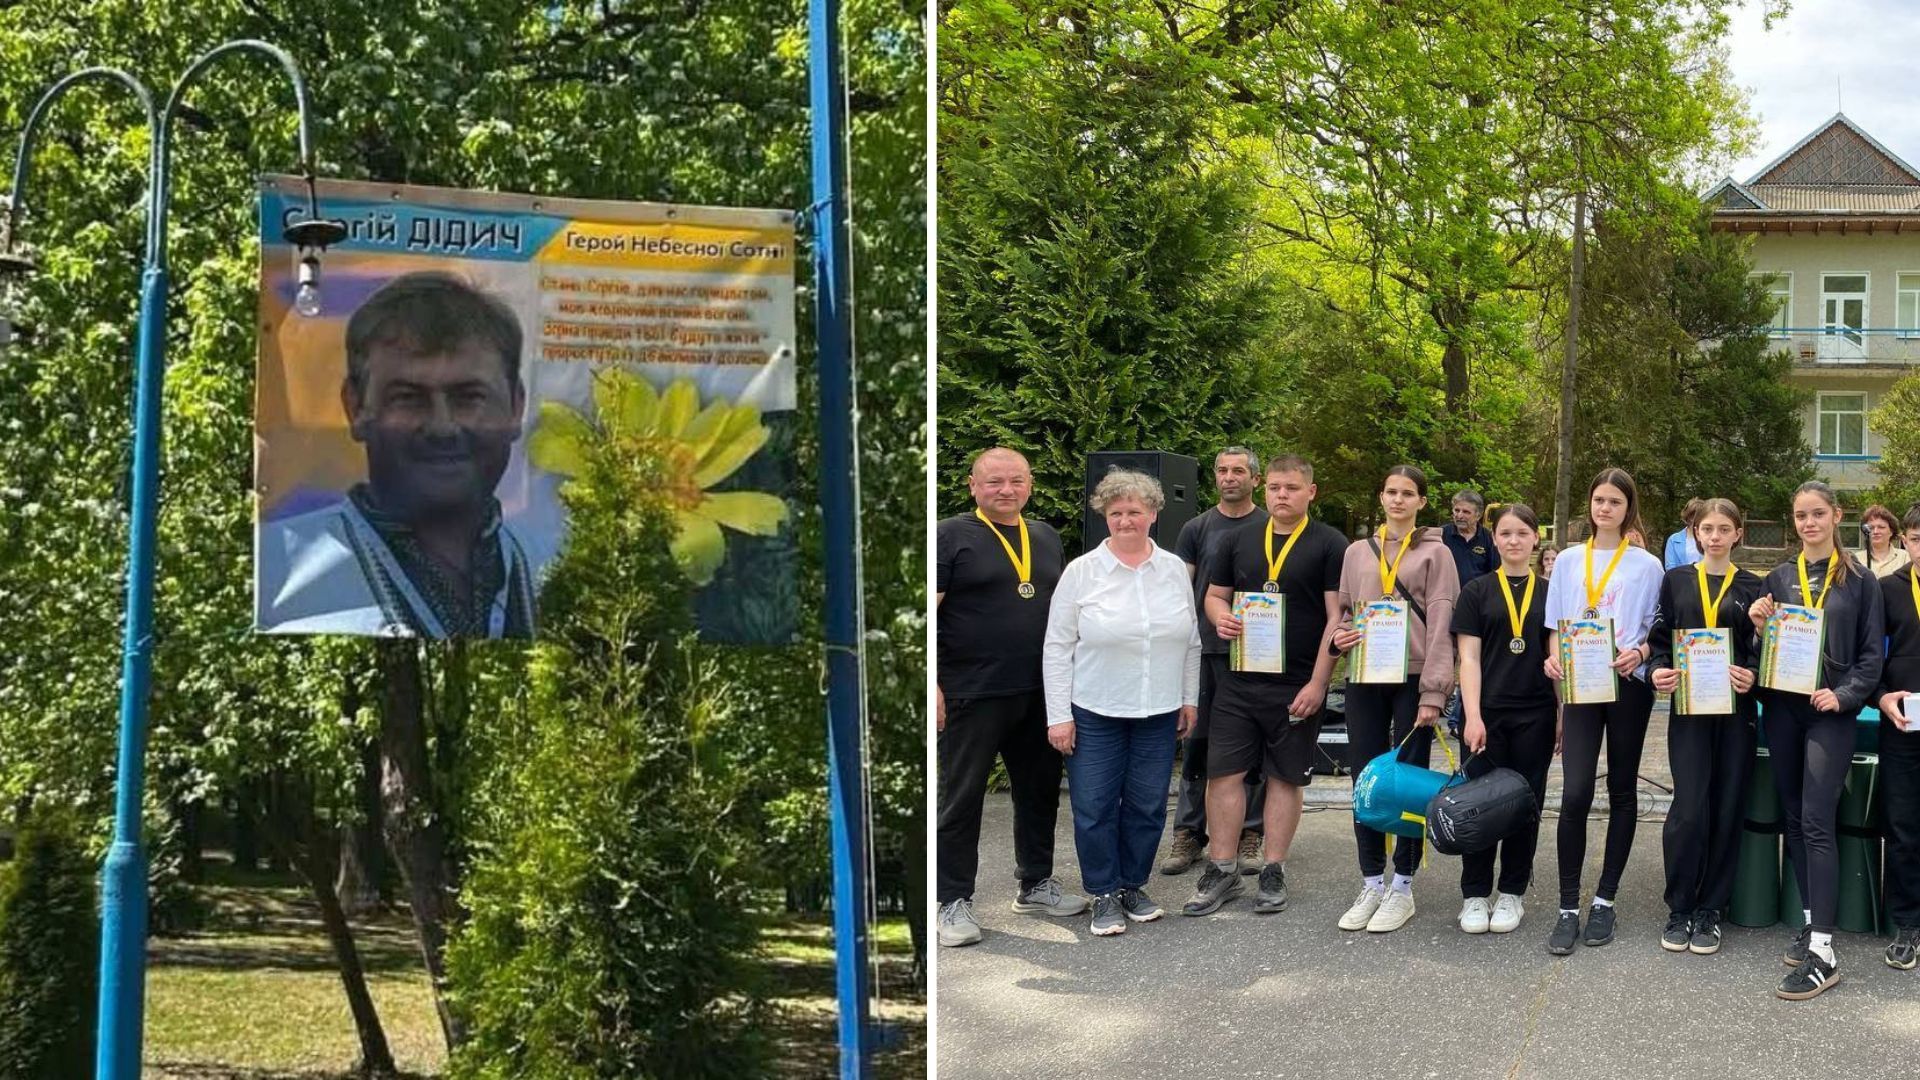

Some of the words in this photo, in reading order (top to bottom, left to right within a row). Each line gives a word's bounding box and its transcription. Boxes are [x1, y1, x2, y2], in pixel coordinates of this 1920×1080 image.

[282, 207, 397, 243] Сгій
[407, 216, 523, 253] ДІДИЧ
[566, 231, 626, 252] Герой
[631, 233, 724, 257] Небесної
[729, 240, 785, 260] Сотні
[1785, 624, 1818, 635] ГРАМОТА
